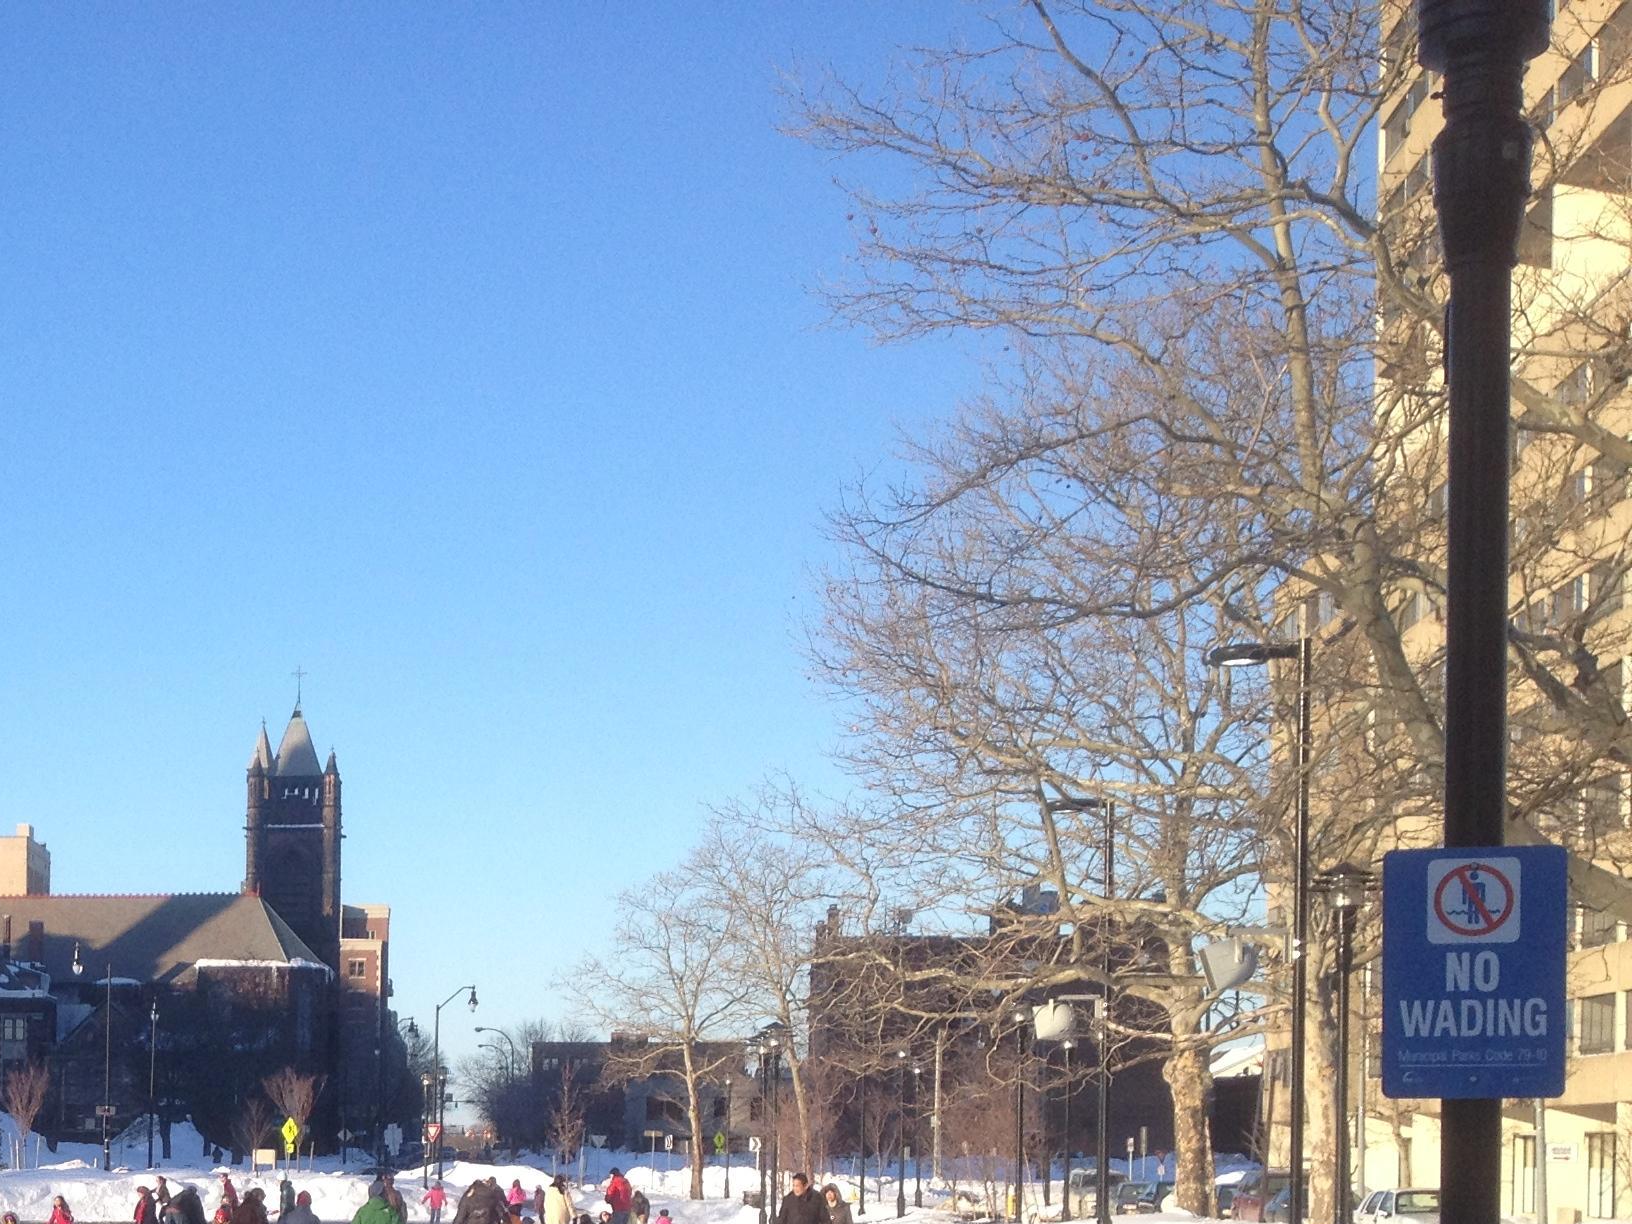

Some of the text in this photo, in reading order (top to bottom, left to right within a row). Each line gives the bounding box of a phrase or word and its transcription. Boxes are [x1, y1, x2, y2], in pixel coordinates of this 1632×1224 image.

[1445, 951, 1500, 992] NO
[1399, 998, 1548, 1038] WADING
[1485, 1048, 1513, 1061] Code
